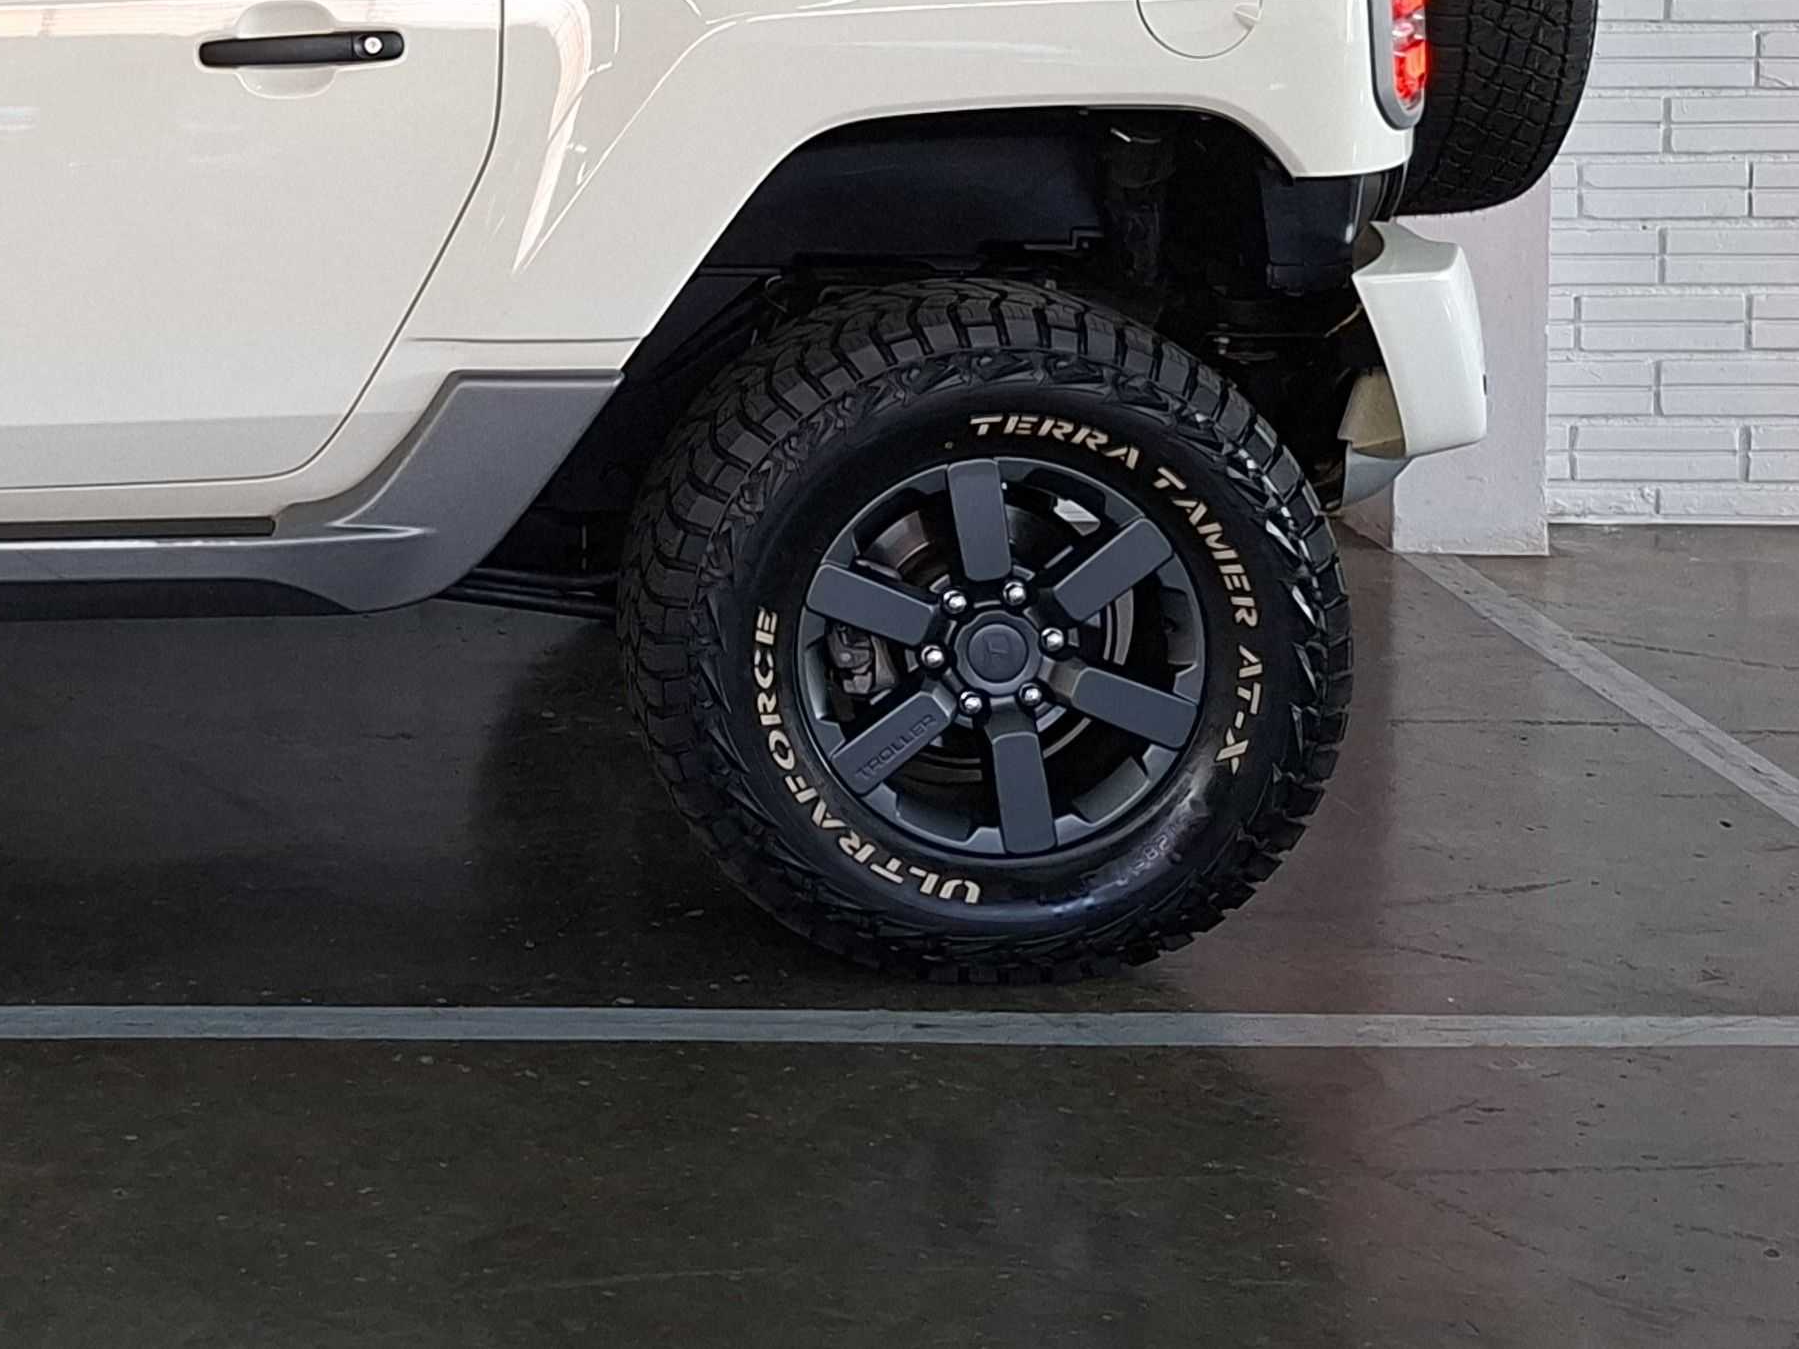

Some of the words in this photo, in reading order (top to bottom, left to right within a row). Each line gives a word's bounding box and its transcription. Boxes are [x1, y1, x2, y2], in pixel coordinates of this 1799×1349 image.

[856, 713, 937, 777] TROLLER
[969, 414, 1142, 471] TERRA
[1153, 466, 1261, 629] TAMER
[1214, 644, 1263, 777] AT-X
[752, 605, 982, 905] ULTRAFORCE
